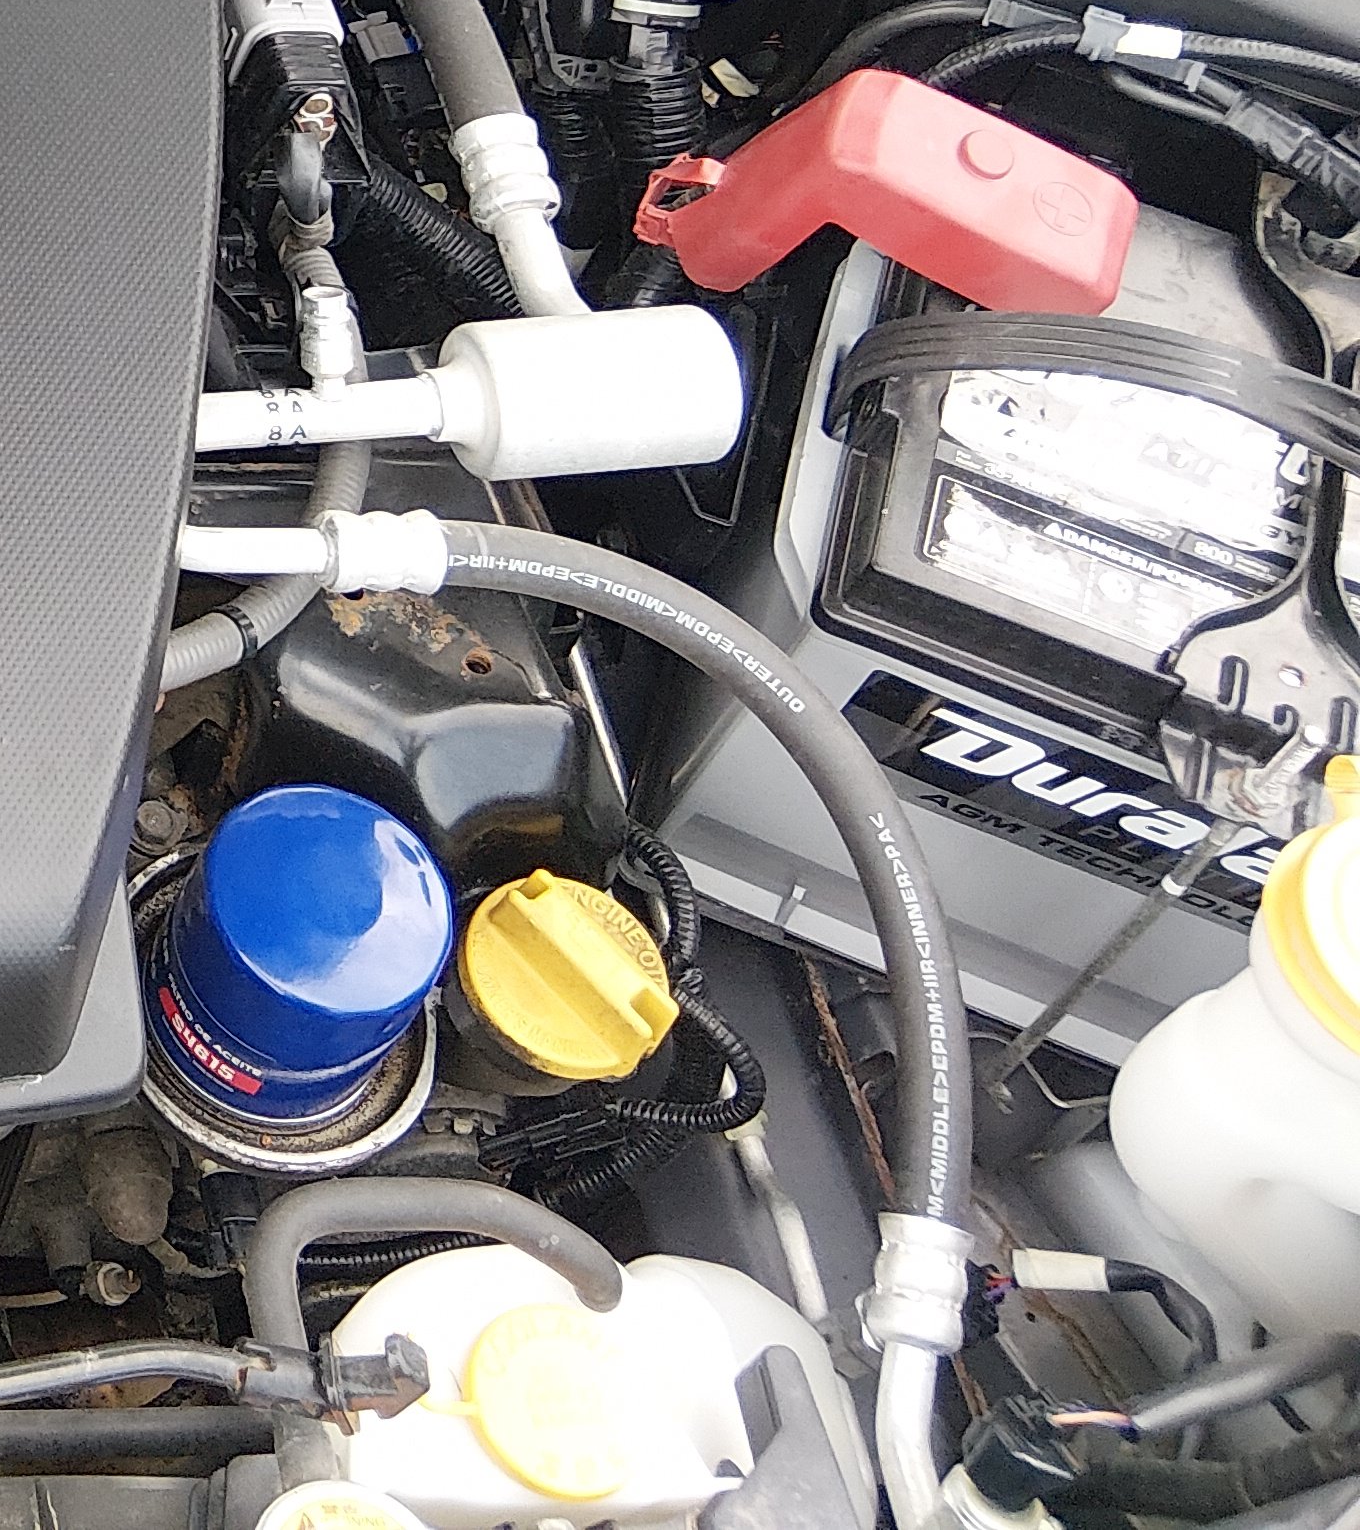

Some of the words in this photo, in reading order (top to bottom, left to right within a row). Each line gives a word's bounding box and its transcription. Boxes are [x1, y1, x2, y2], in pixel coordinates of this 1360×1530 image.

[1193, 540, 1230, 565] 800
[917, 793, 1027, 836] AGM
[171, 1011, 236, 1085] S4615
[193, 1022, 213, 1043] DE
